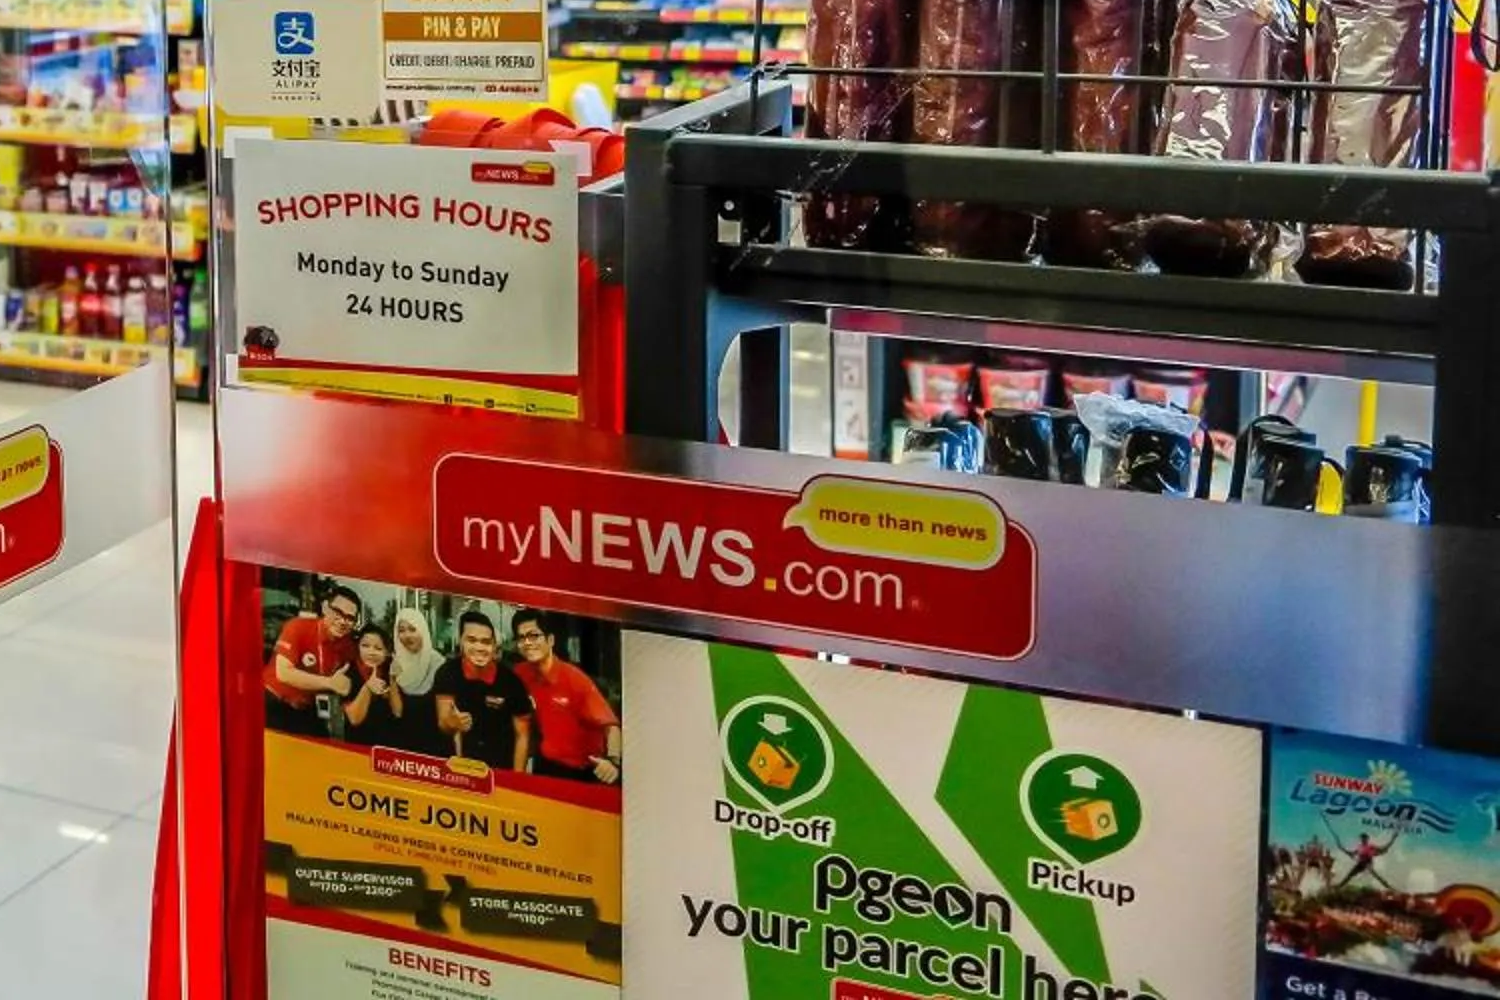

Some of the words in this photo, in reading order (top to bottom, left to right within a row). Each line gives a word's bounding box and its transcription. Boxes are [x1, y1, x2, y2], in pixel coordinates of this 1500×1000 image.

[422, 15, 451, 39] PIN
[454, 16, 467, 38] &
[471, 15, 502, 39] PAY
[271, 59, 321, 78] 支付宝
[495, 55, 535, 69] PREPAID
[275, 79, 317, 89] ALIPAY
[257, 192, 421, 226] SHOPPING
[432, 196, 553, 244] HOURS
[297, 251, 386, 282] Monday
[391, 261, 414, 281] to
[421, 261, 510, 293] Sunday
[345, 294, 373, 317] 24
[380, 297, 465, 323] HOURS
[15, 455, 41, 475] news
[818, 504, 872, 528] more
[877, 512, 926, 534] than
[930, 521, 988, 542] news
[462, 506, 904, 611] myNEWS.com
[1290, 776, 1418, 821] Lagoon
[1313, 772, 1383, 794] SUNWAY
[327, 785, 410, 821] COME
[419, 804, 489, 837] JOIN
[501, 822, 540, 847] US
[714, 799, 833, 844] Drop-off
[285, 811, 349, 833] MALAYSIA'S
[351, 826, 400, 844] LEADING
[450, 846, 534, 872] CONVENIENCE
[535, 863, 594, 884] RETAILER
[295, 867, 339, 881] OUTLET
[341, 871, 414, 887] SUPERVISOR
[1030, 862, 1138, 906] Pickup
[468, 896, 511, 911] STORE
[513, 900, 585, 918] ASSOCIATE
[681, 893, 809, 953] your
[823, 923, 1002, 994] parcel
[388, 946, 492, 988] BENEFITS
[1285, 975, 1327, 998] Get
